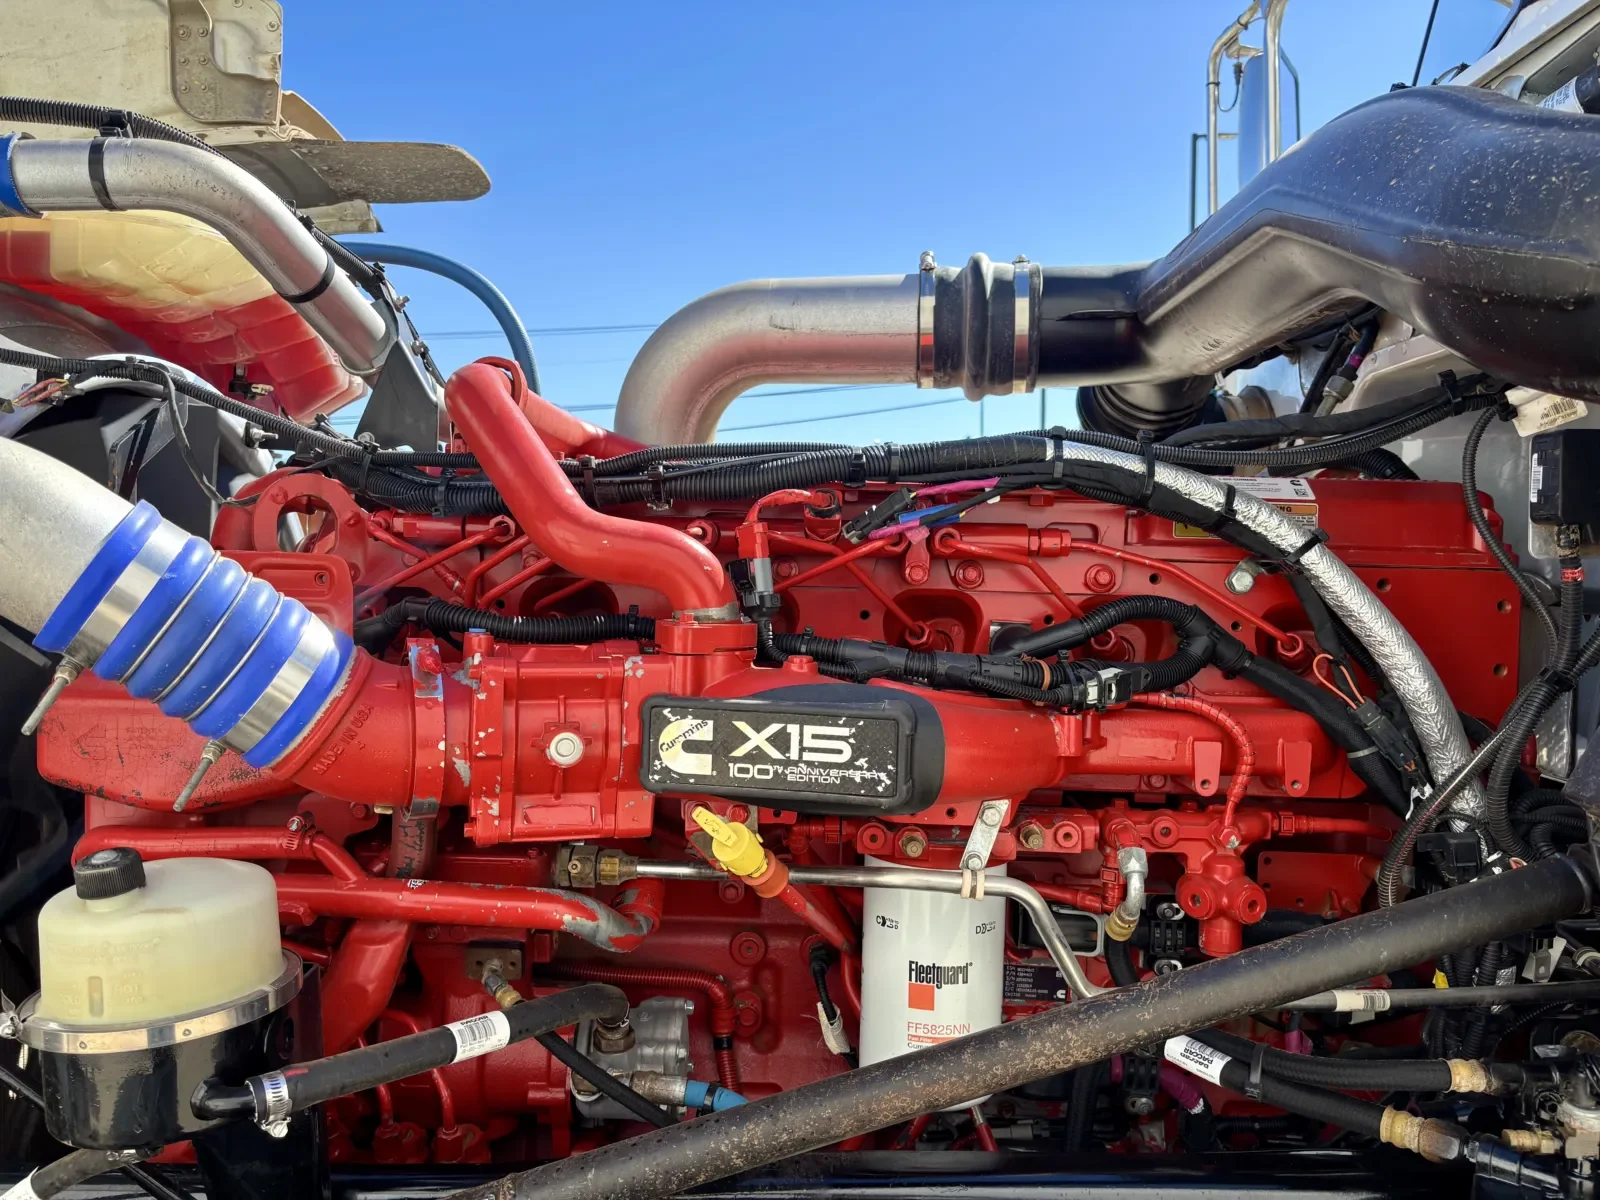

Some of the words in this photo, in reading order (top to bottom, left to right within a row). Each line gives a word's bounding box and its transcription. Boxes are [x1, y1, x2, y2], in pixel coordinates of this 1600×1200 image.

[312, 742, 345, 776] MADE
[339, 726, 358, 745] IN
[351, 703, 374, 729] USA
[659, 718, 709, 754] Cummins
[728, 720, 852, 763] X15
[787, 774, 841, 785] EDITION
[907, 1021, 971, 1036] FF5825NN
[1184, 1047, 1214, 1065] PACCAR
